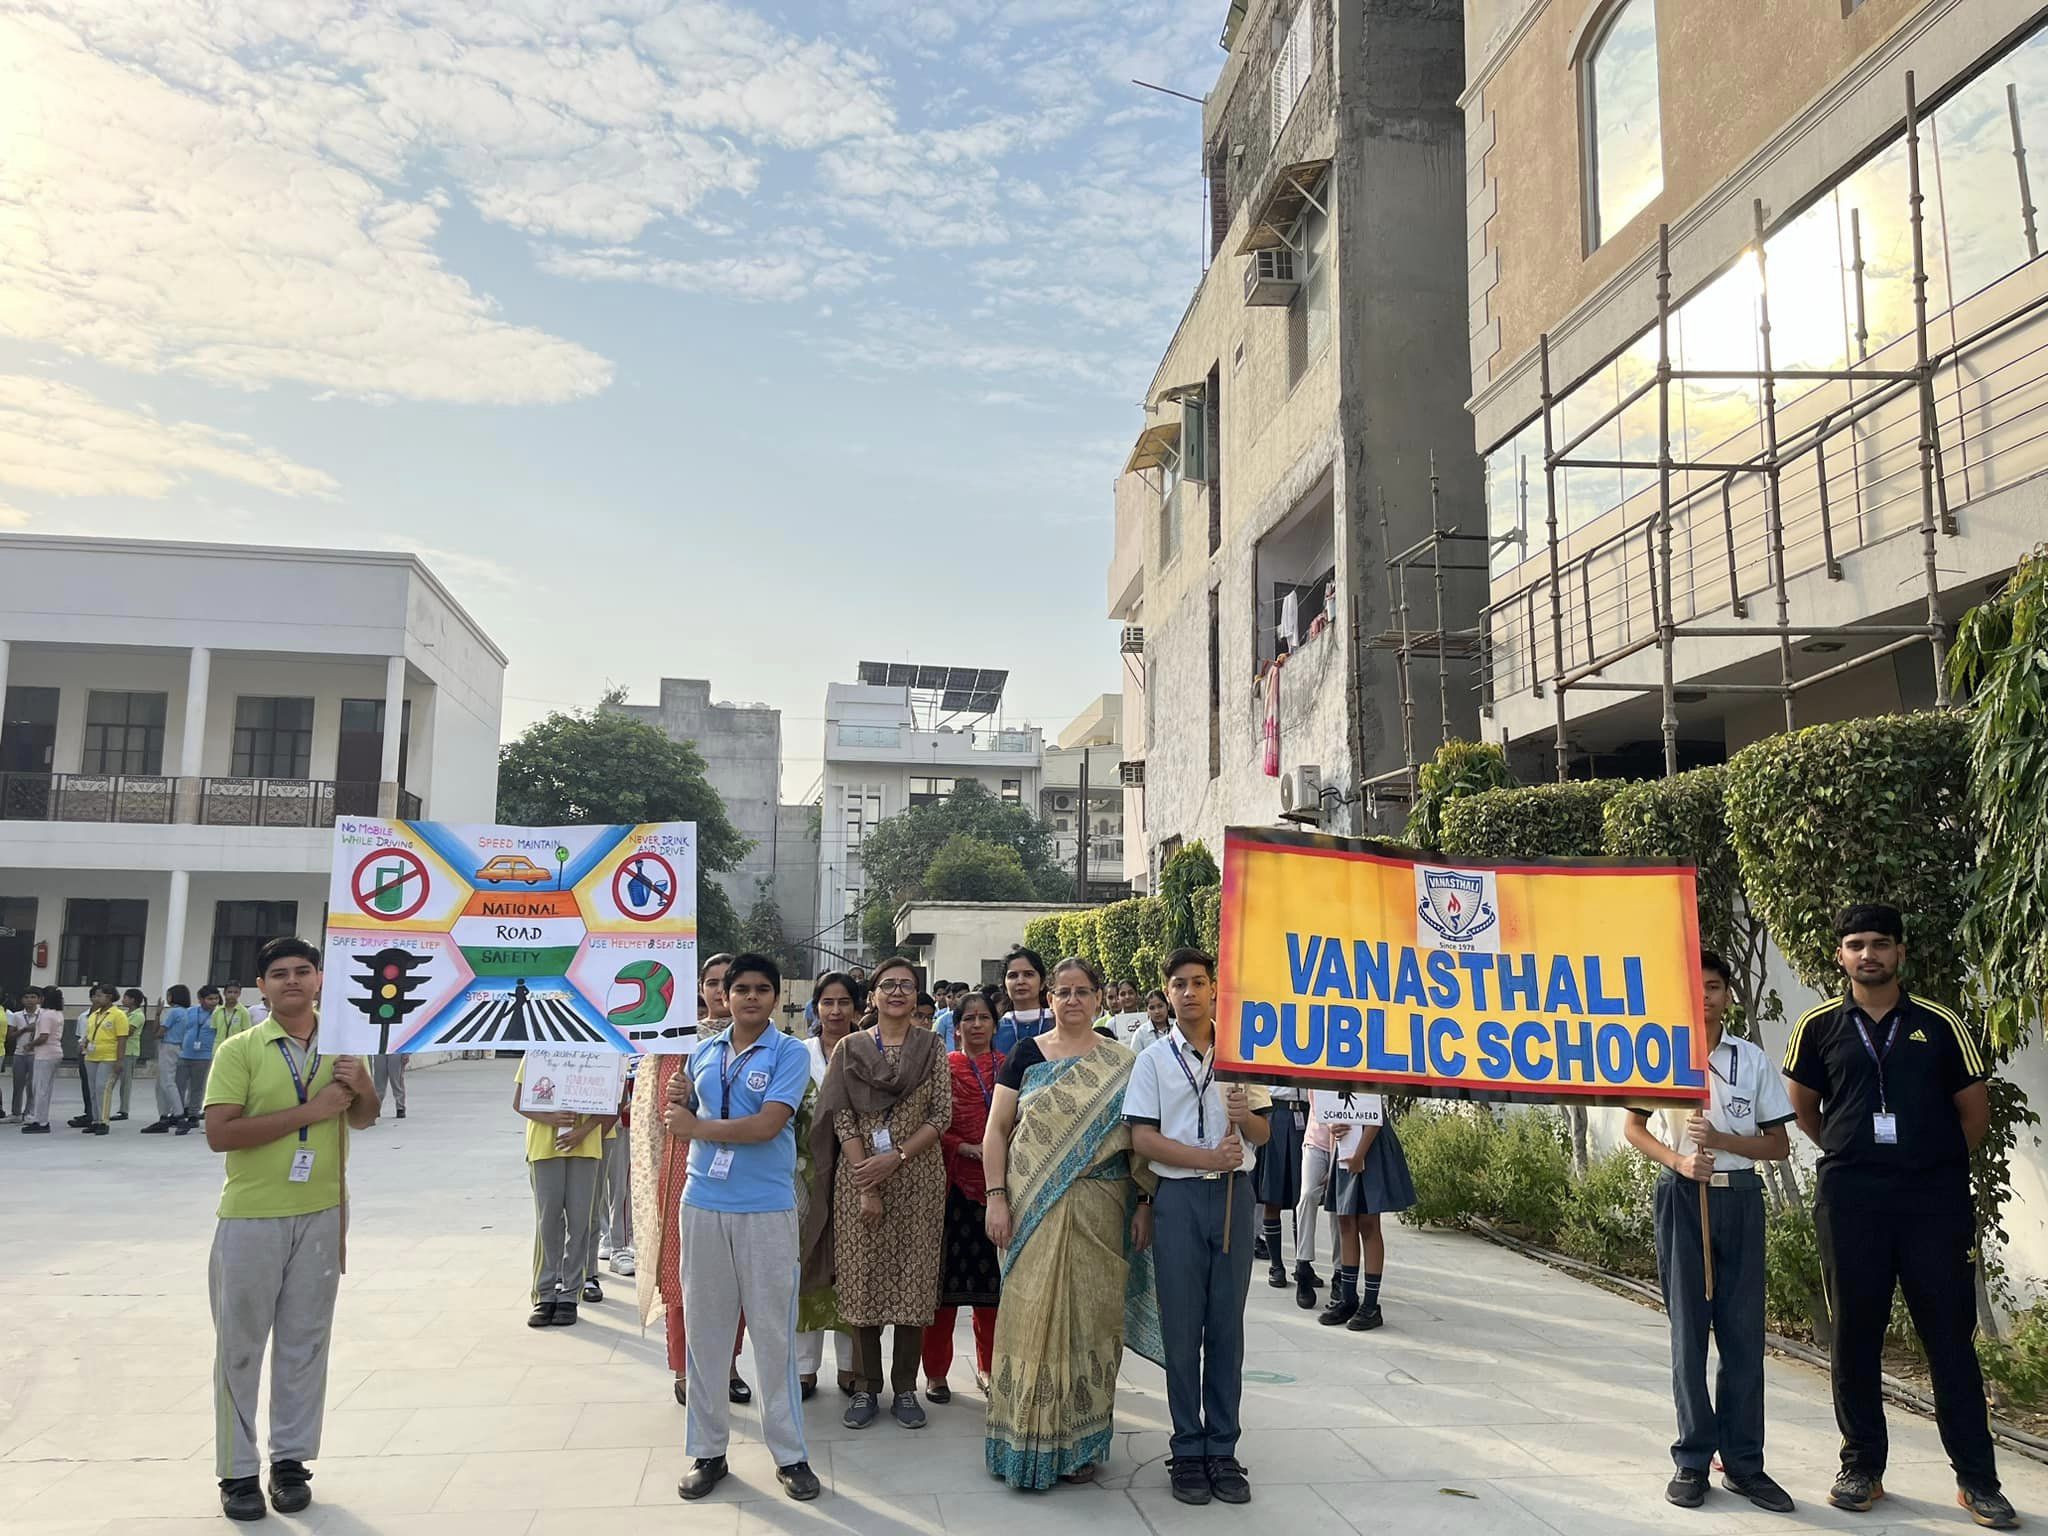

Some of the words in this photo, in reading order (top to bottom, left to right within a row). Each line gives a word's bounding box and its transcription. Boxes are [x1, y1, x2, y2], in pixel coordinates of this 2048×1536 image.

[341, 822, 357, 833] NO
[358, 823, 393, 836] MOBILE
[341, 834, 374, 846] WHILE
[375, 836, 414, 849] DRIVING
[479, 836, 513, 849] SPEED
[517, 839, 561, 849] MAINTAIN
[628, 835, 660, 846] NEVER
[662, 835, 690, 847] DRINK
[638, 844, 657, 853] AND
[659, 846, 686, 856] DRIVE
[1428, 877, 1480, 893] VANASTHALI
[482, 902, 561, 916] NATIONAL
[496, 925, 542, 941] ROAD
[332, 935, 358, 947] SAFE
[359, 936, 390, 948] DRIVE
[391, 937, 418, 949] SAFE
[588, 938, 608, 949] USE
[611, 938, 647, 950] HELMET
[656, 939, 675, 949] SEAT
[675, 939, 695, 949] BELT
[1440, 942, 1457, 950] Since
[1458, 943, 1476, 952] 1978
[482, 949, 541, 964] SAFETY
[1285, 932, 1646, 1016] VANASTHALI
[464, 991, 489, 1002] STOP
[1476, 1019, 1706, 1088] SCHOOL
[1323, 1110, 1353, 1120] SCHOOL
[1355, 1111, 1379, 1120] AHEAD
